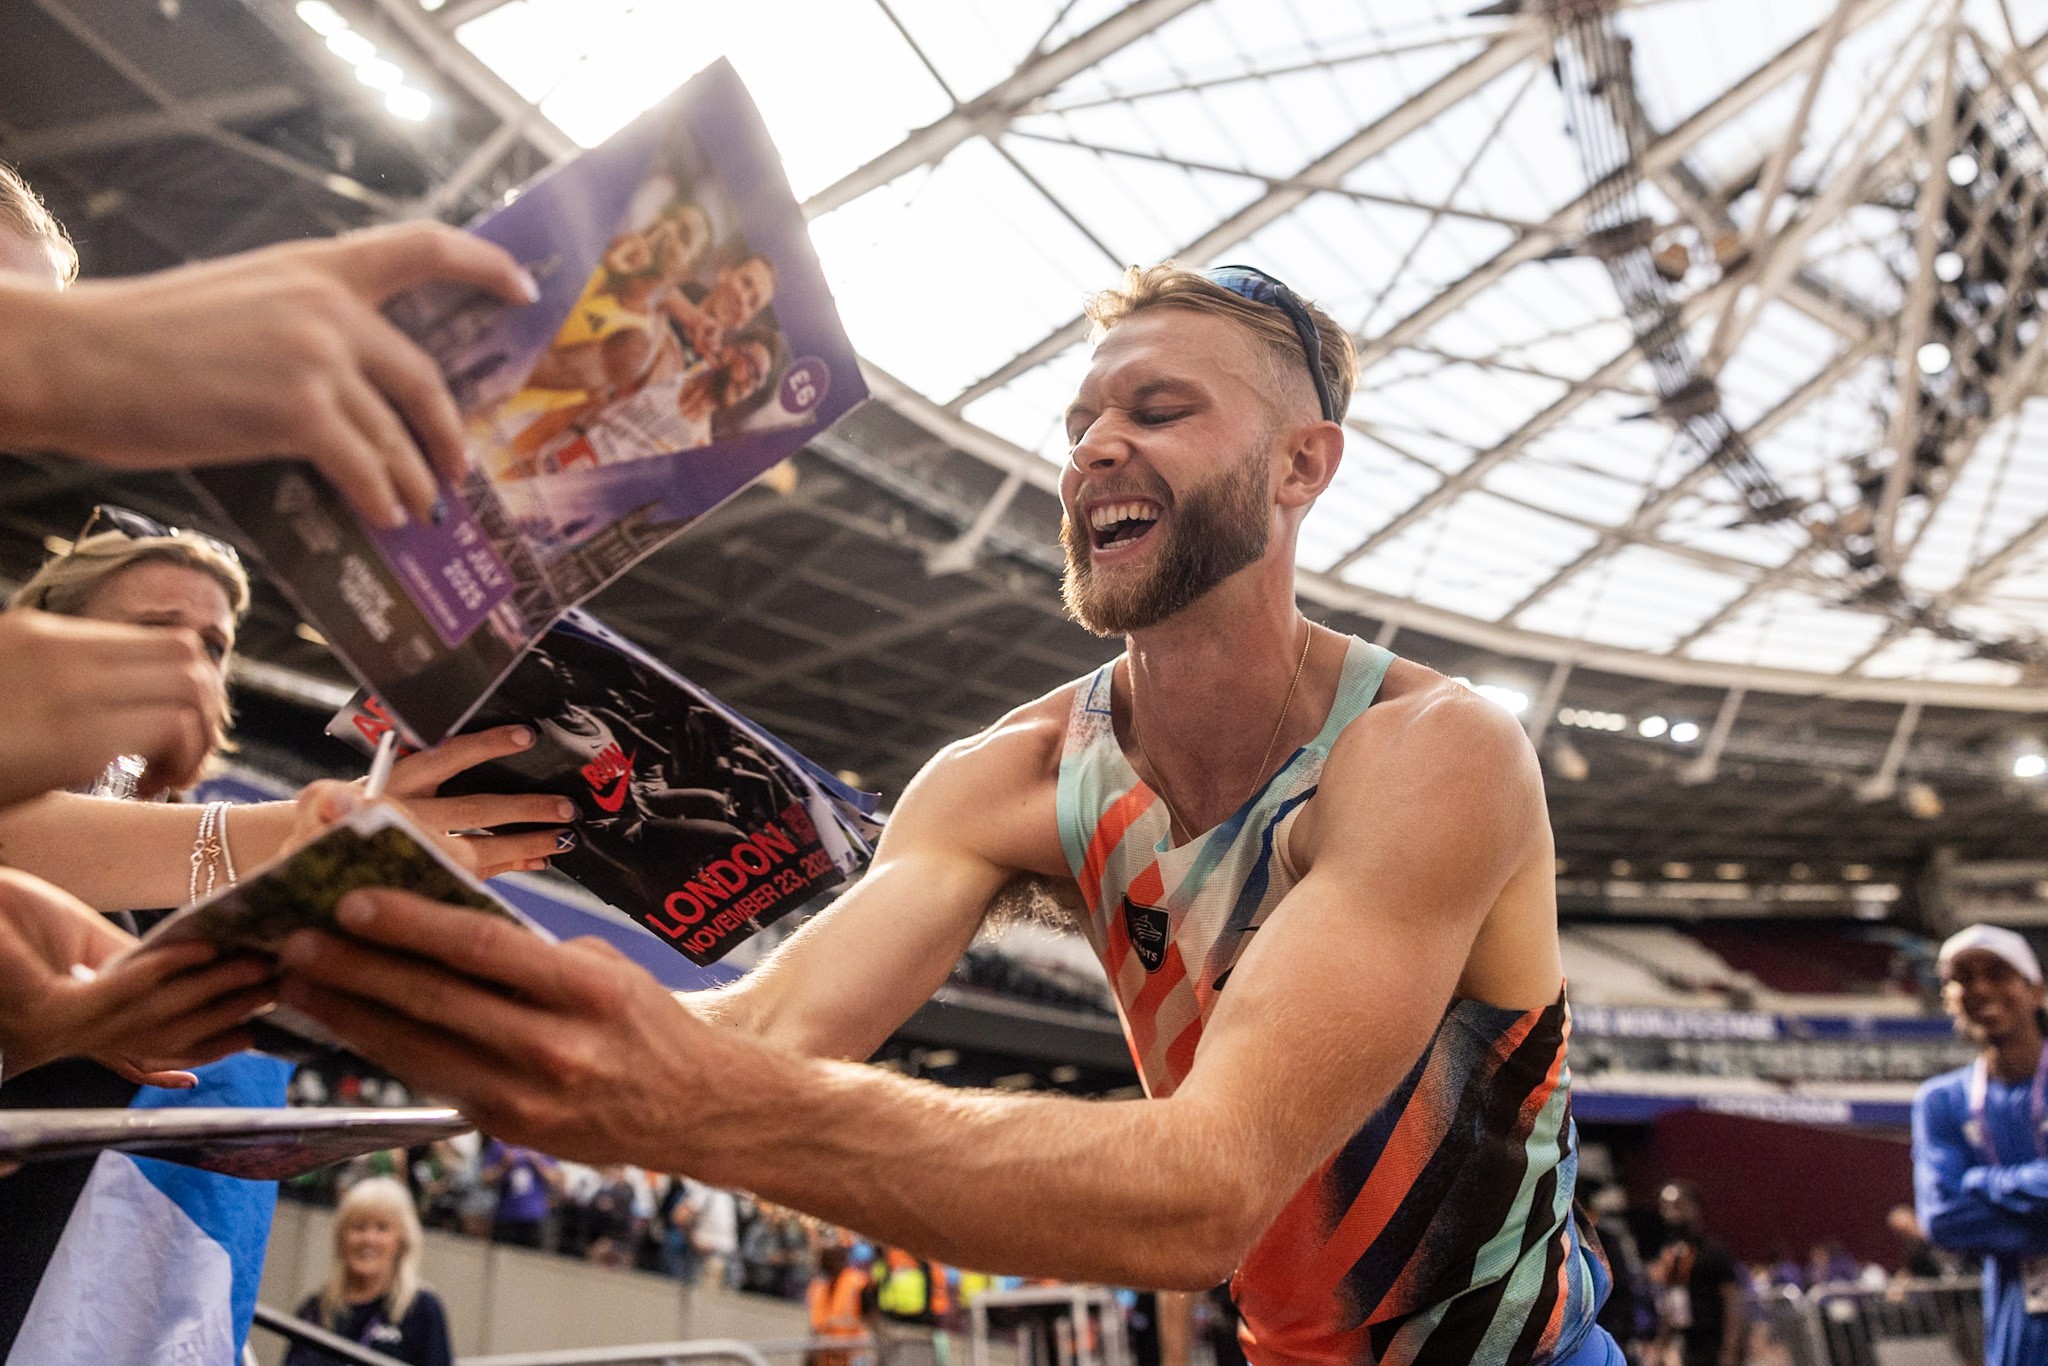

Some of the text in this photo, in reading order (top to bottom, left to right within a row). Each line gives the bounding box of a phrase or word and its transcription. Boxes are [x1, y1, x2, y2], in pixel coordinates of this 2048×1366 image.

[788, 369, 816, 407] £6
[466, 549, 505, 589] JULY
[645, 821, 798, 939] LONDON
[681, 883, 781, 955] NOVEMBER
[773, 868, 810, 895] 23,
